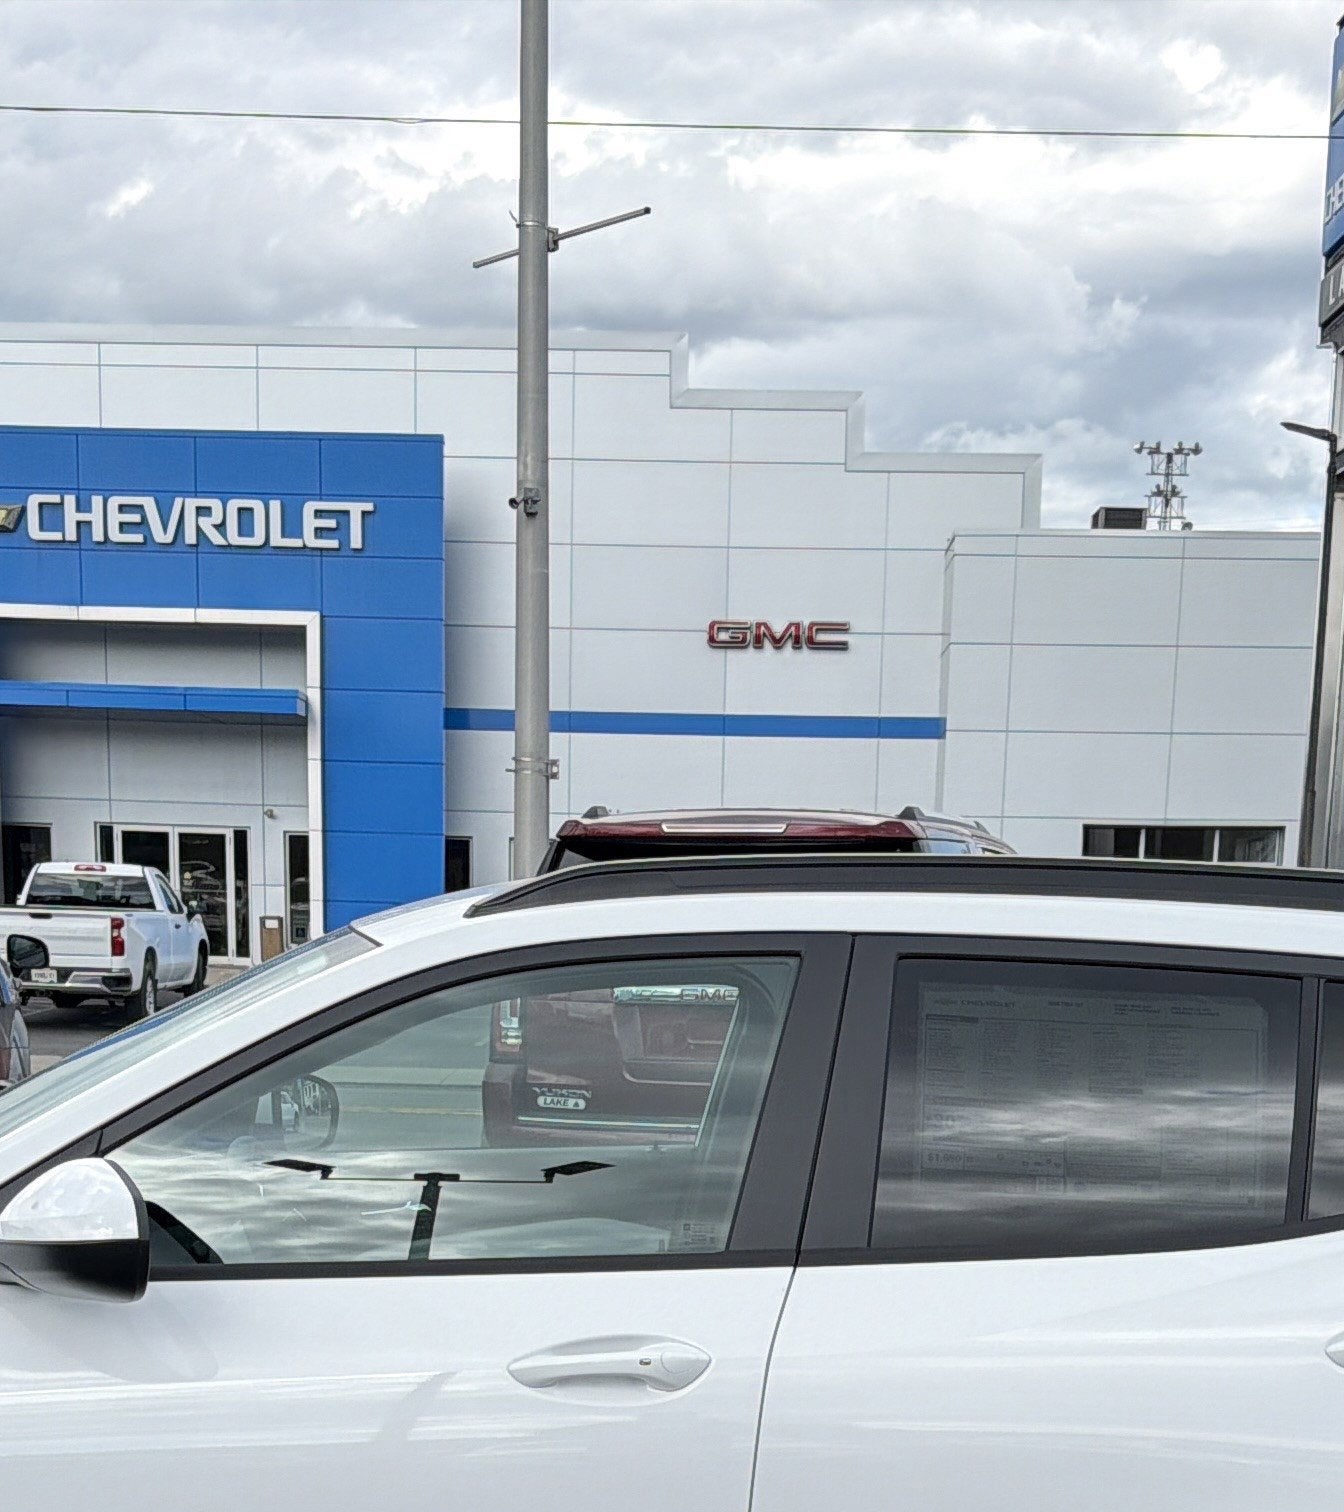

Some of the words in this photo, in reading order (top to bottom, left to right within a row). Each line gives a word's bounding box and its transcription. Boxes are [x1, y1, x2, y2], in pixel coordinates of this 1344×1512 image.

[26, 493, 375, 551] CHEVROLET
[707, 620, 850, 651] GMC
[543, 1097, 570, 1107] LAKE
